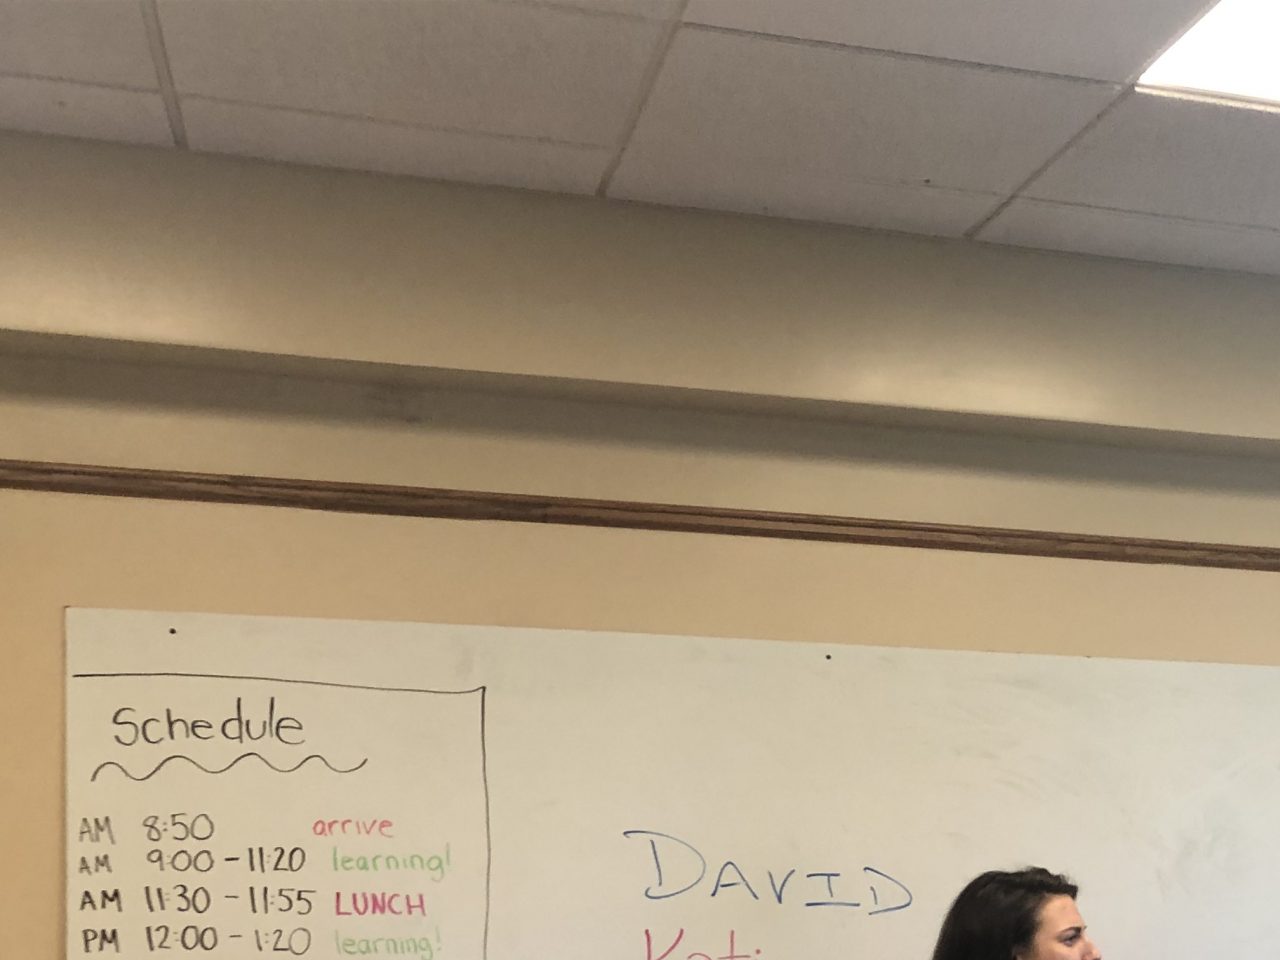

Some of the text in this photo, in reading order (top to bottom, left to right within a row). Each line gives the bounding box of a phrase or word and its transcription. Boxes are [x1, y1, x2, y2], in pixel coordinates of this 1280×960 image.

[112, 697, 305, 746] Schedule
[79, 812, 394, 844] AM 8:50 arrive
[78, 854, 112, 875] AM
[146, 849, 215, 872] 9:00
[332, 842, 450, 882] learning!
[622, 830, 913, 915] DAVID
[79, 888, 122, 912] AM
[144, 884, 211, 914] 11:30
[248, 886, 316, 915] 11:55
[335, 891, 427, 916] LUNCH
[81, 928, 120, 953] PM
[145, 925, 218, 952] 12:00
[254, 927, 311, 955] 1:20
